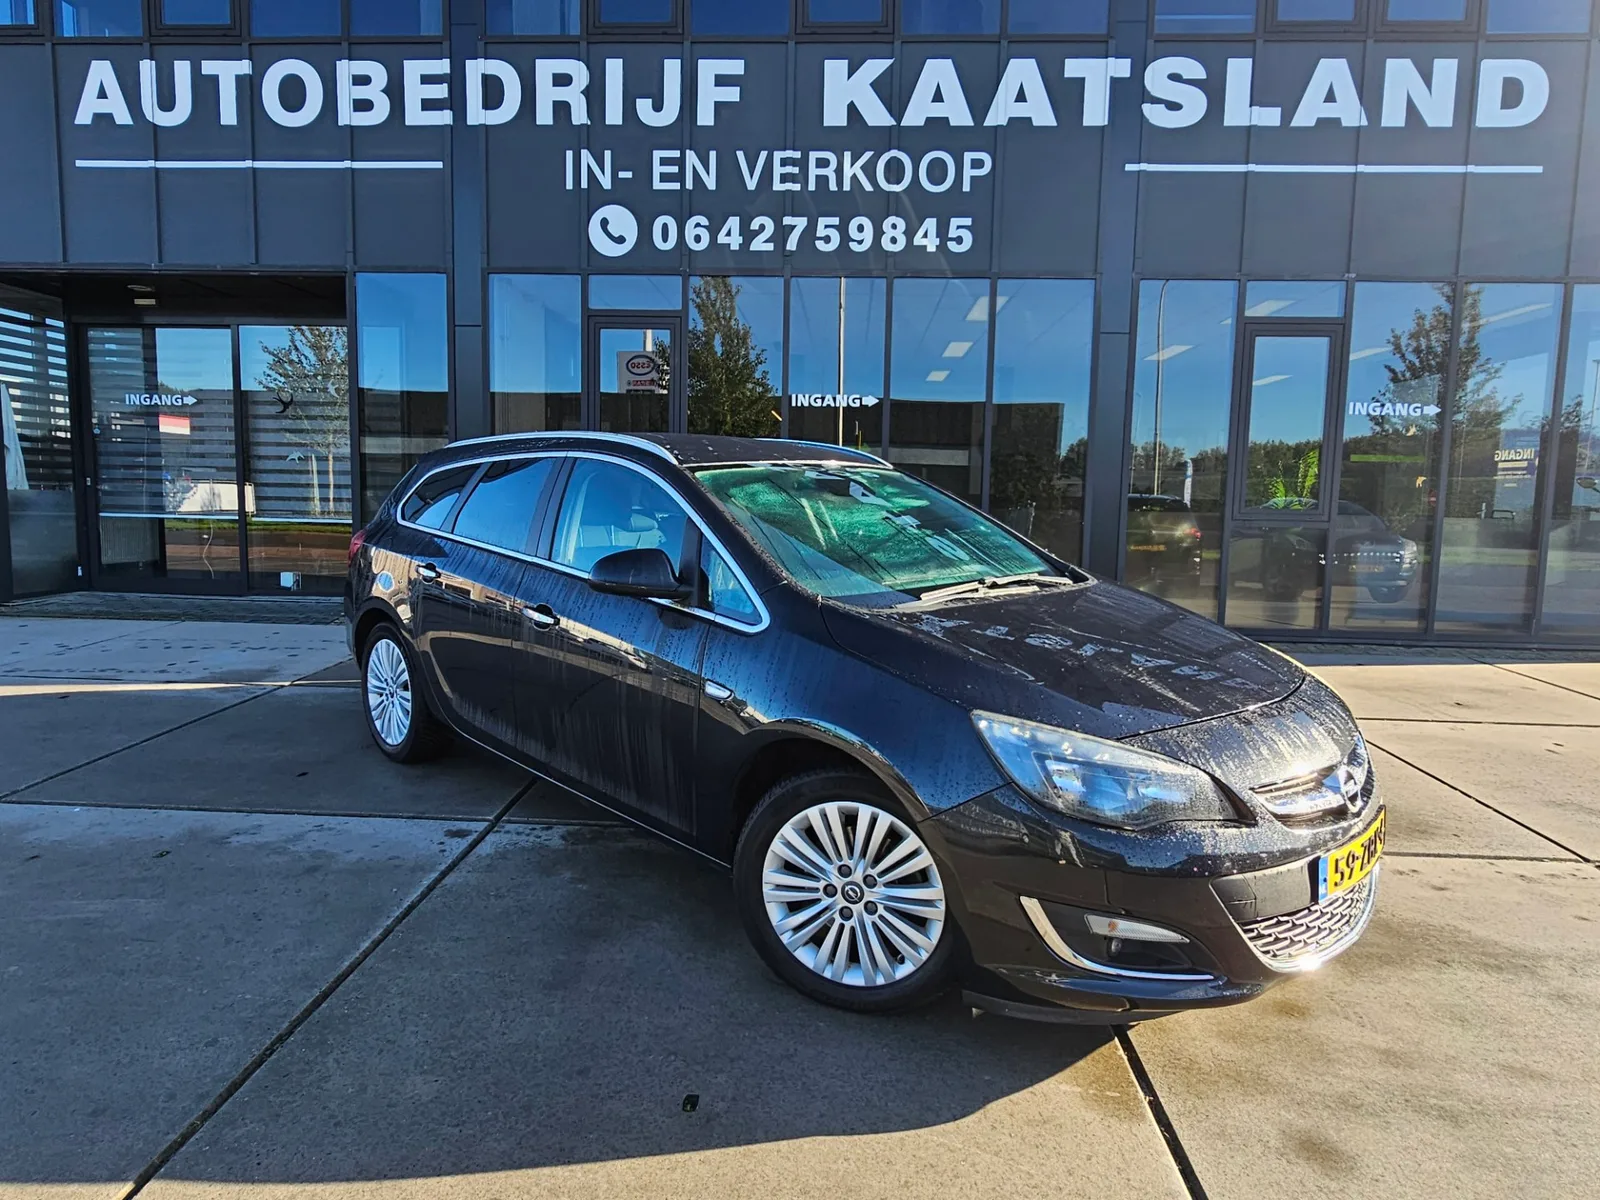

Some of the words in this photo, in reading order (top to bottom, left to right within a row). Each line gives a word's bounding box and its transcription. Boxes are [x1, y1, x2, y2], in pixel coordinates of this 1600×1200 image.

[75, 58, 745, 128] AUTOBEDRIJF
[823, 56, 1550, 129] KAATSLAND
[565, 149, 633, 190] IN-
[652, 149, 717, 191] EN
[736, 149, 992, 193] VERKOOP
[652, 215, 973, 253] 0642759845
[125, 393, 182, 405] INGANG
[791, 393, 861, 407] INGANG
[1348, 401, 1421, 416] INGANG
